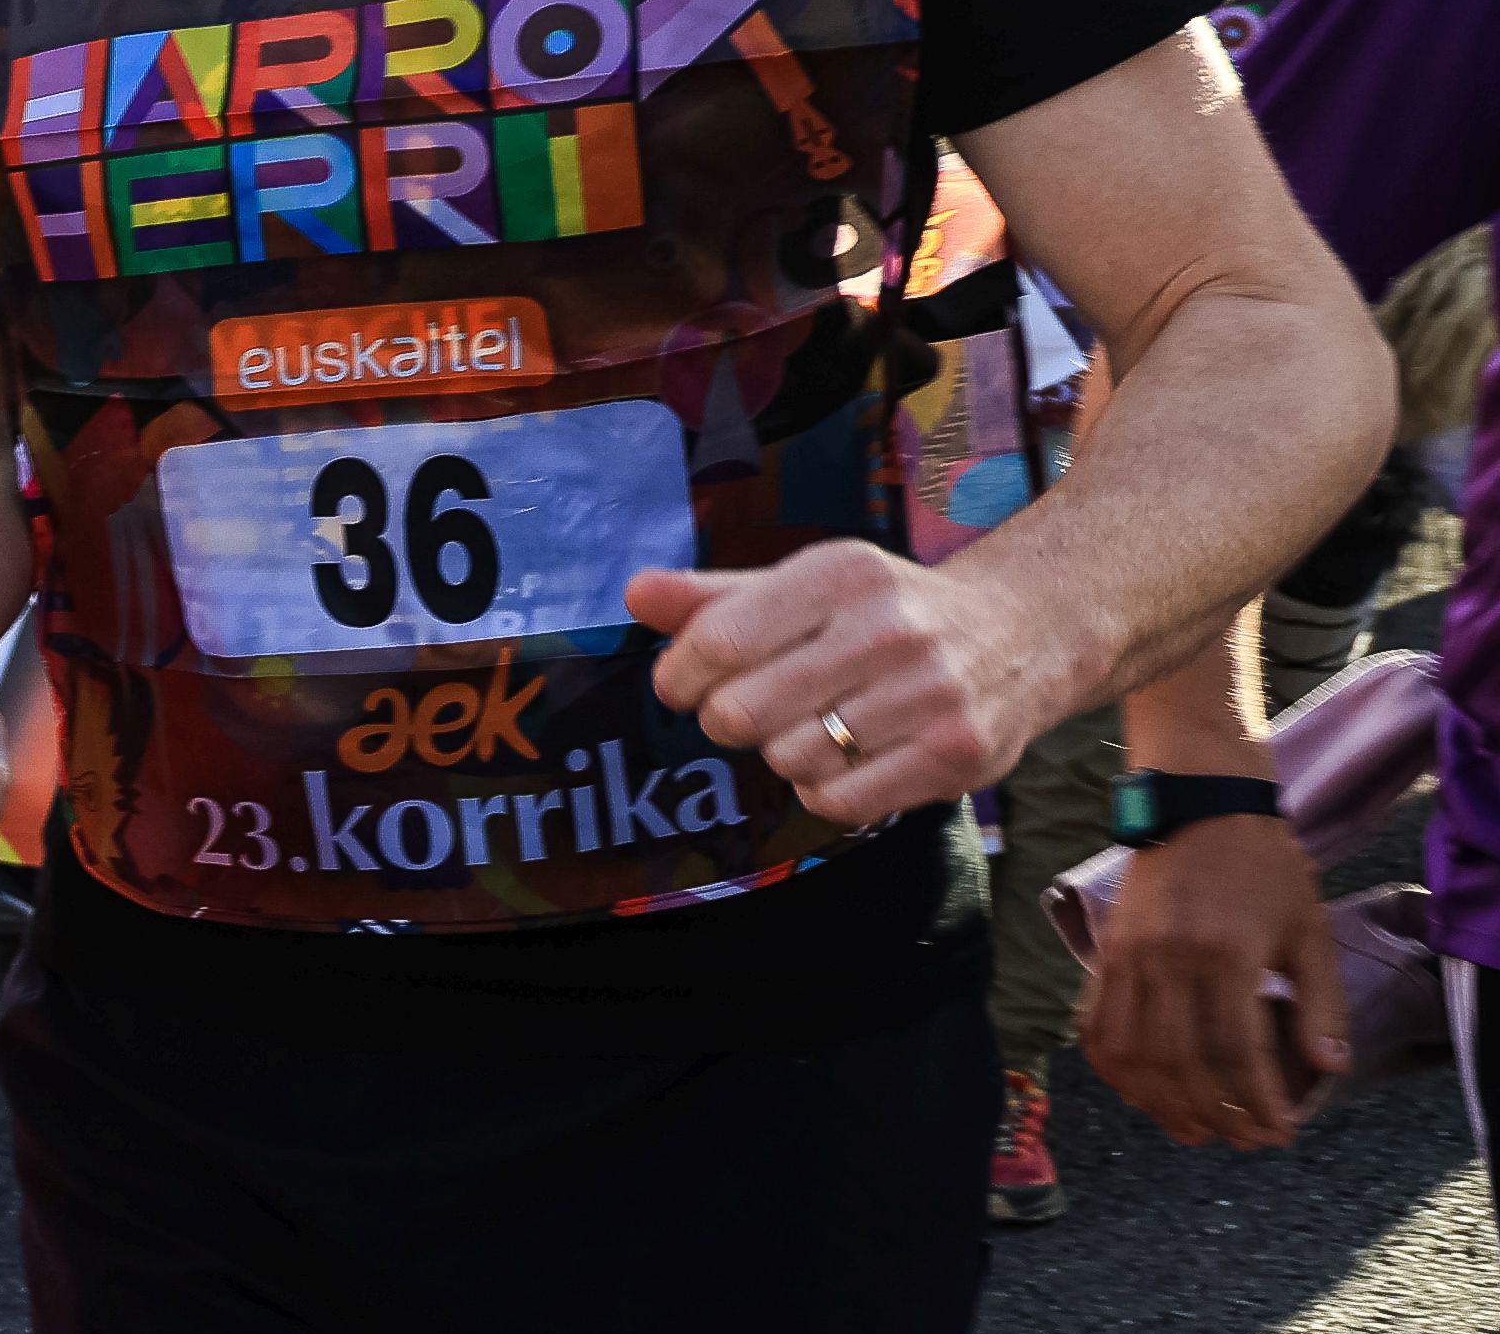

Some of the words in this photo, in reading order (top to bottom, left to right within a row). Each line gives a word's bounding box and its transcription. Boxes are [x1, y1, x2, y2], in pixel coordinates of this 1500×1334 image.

[8, 103, 643, 282] HERRI
[237, 316, 522, 393] euskaltel
[310, 456, 497, 629] 36
[337, 647, 546, 774] aek
